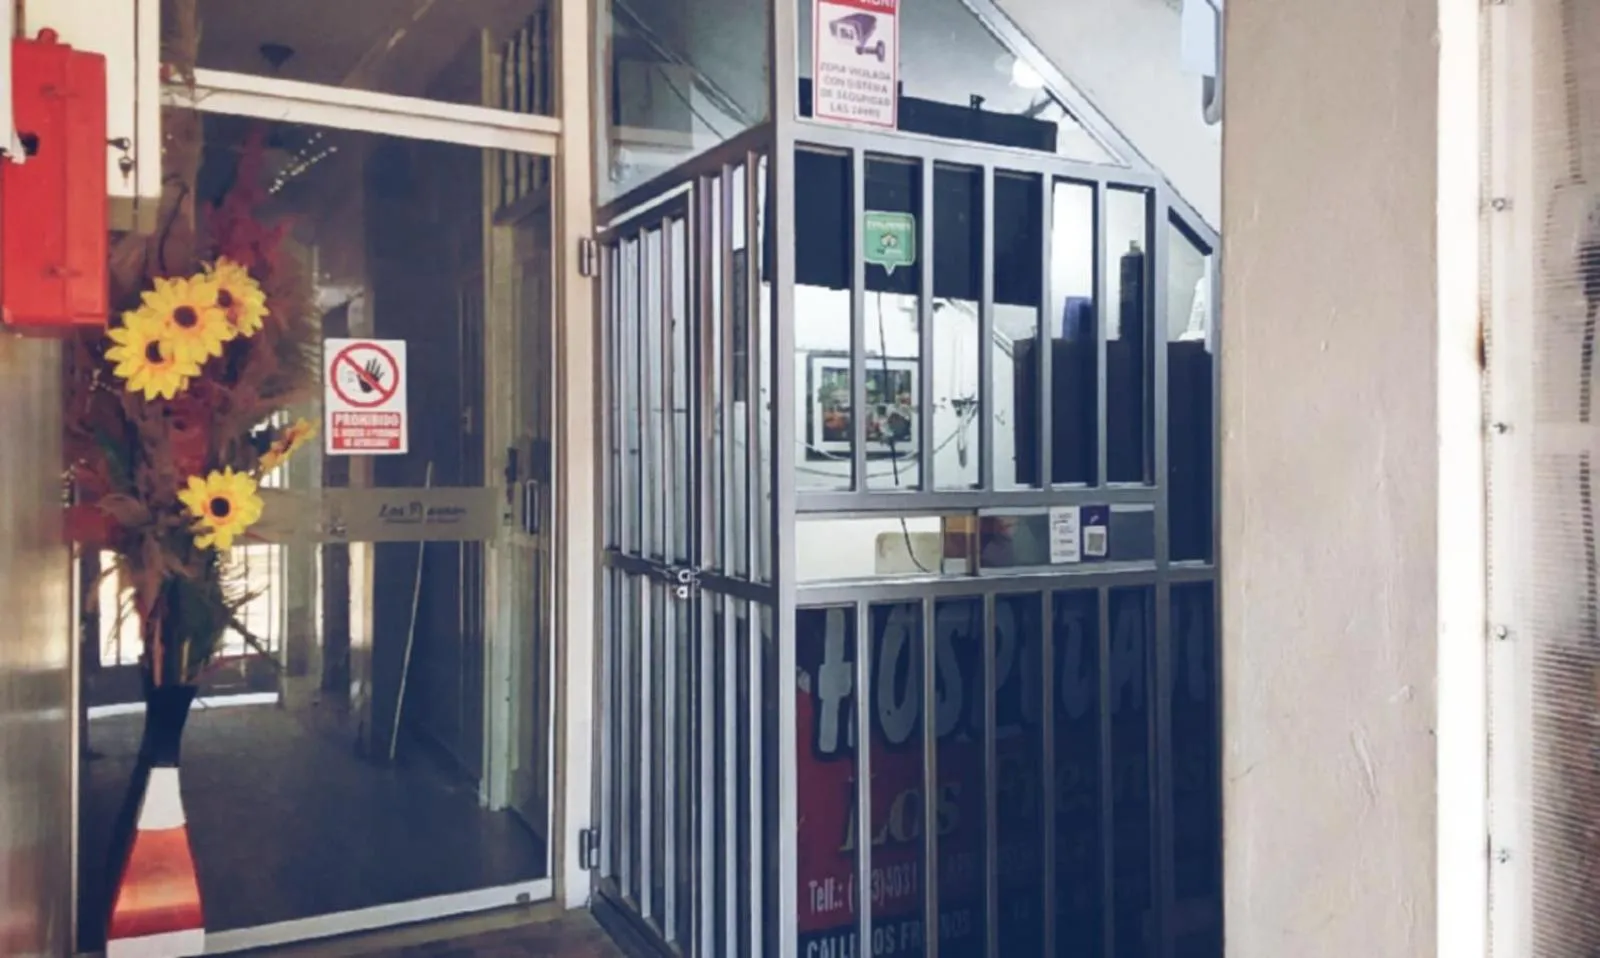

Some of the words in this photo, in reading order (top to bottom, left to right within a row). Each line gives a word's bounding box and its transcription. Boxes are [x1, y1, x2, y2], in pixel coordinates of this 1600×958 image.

[823, 75, 845, 87] CON
[335, 412, 399, 427] PROHIBIDO
[867, 925, 896, 956] OS
